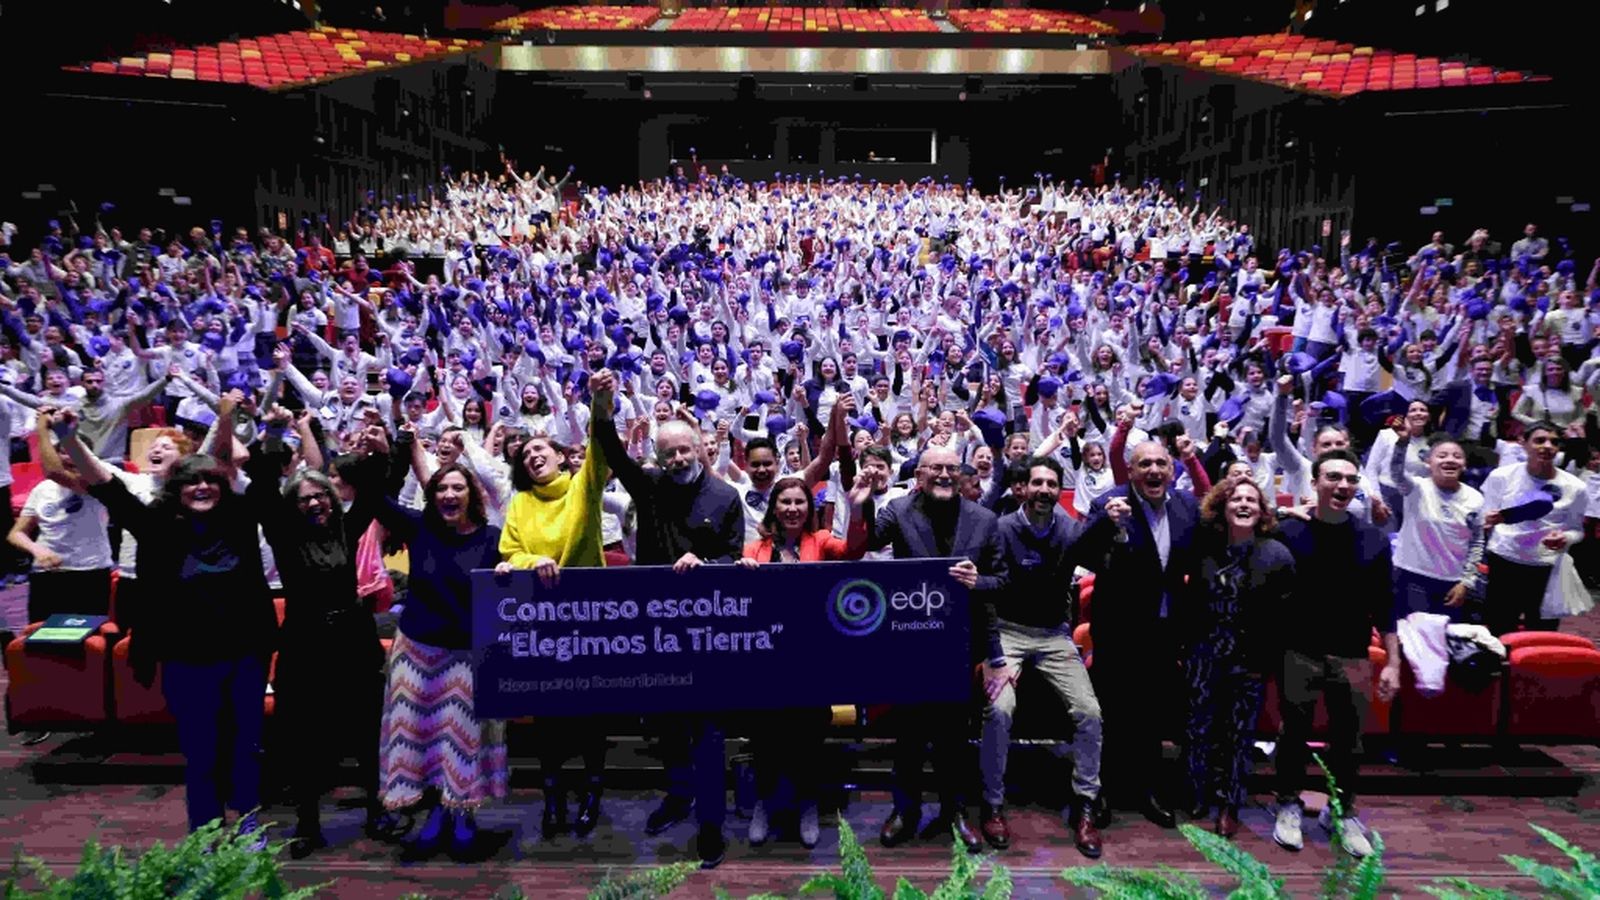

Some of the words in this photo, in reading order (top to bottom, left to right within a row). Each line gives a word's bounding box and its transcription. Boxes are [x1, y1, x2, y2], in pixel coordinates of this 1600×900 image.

[497, 597, 640, 622] Concurso
[646, 590, 753, 618] escolar
[891, 582, 944, 616] edp
[653, 626, 683, 653] la
